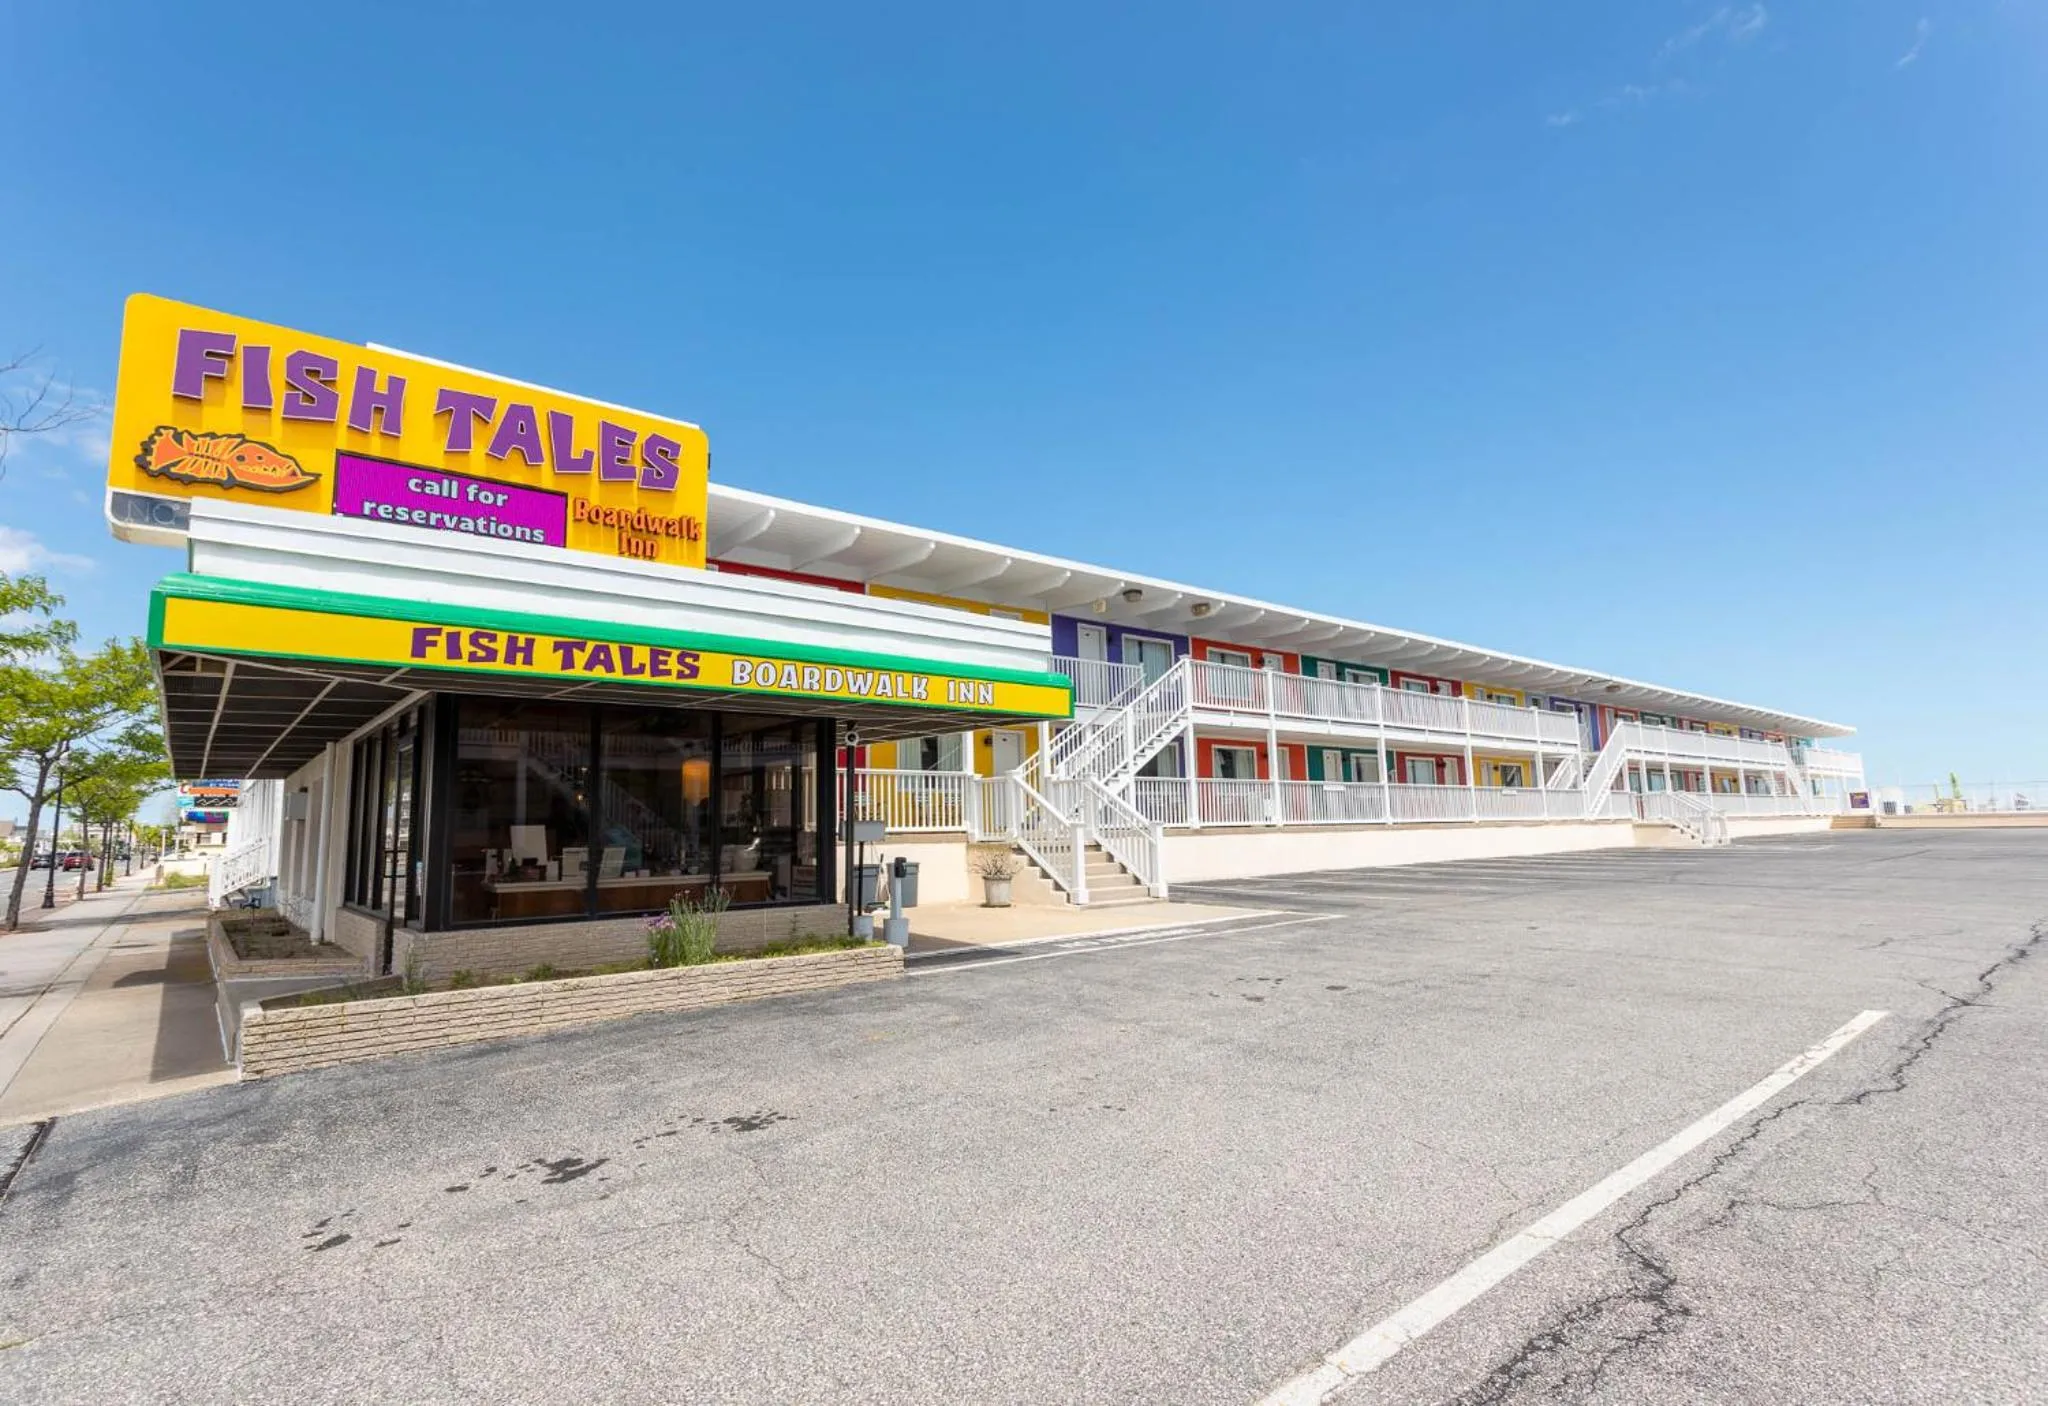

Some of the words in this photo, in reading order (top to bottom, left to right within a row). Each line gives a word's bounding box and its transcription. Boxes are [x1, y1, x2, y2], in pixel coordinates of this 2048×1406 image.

[172, 328, 407, 436] FISH
[434, 388, 682, 491] TALES
[408, 477, 459, 499] call
[466, 484, 509, 507] for
[362, 500, 546, 543] reservations
[573, 497, 702, 541] Boardwalk
[618, 531, 659, 558] Inn
[411, 627, 535, 666] FISH
[553, 641, 700, 680] TALES
[731, 659, 929, 700] BOARDWALK
[946, 679, 995, 705] INN
